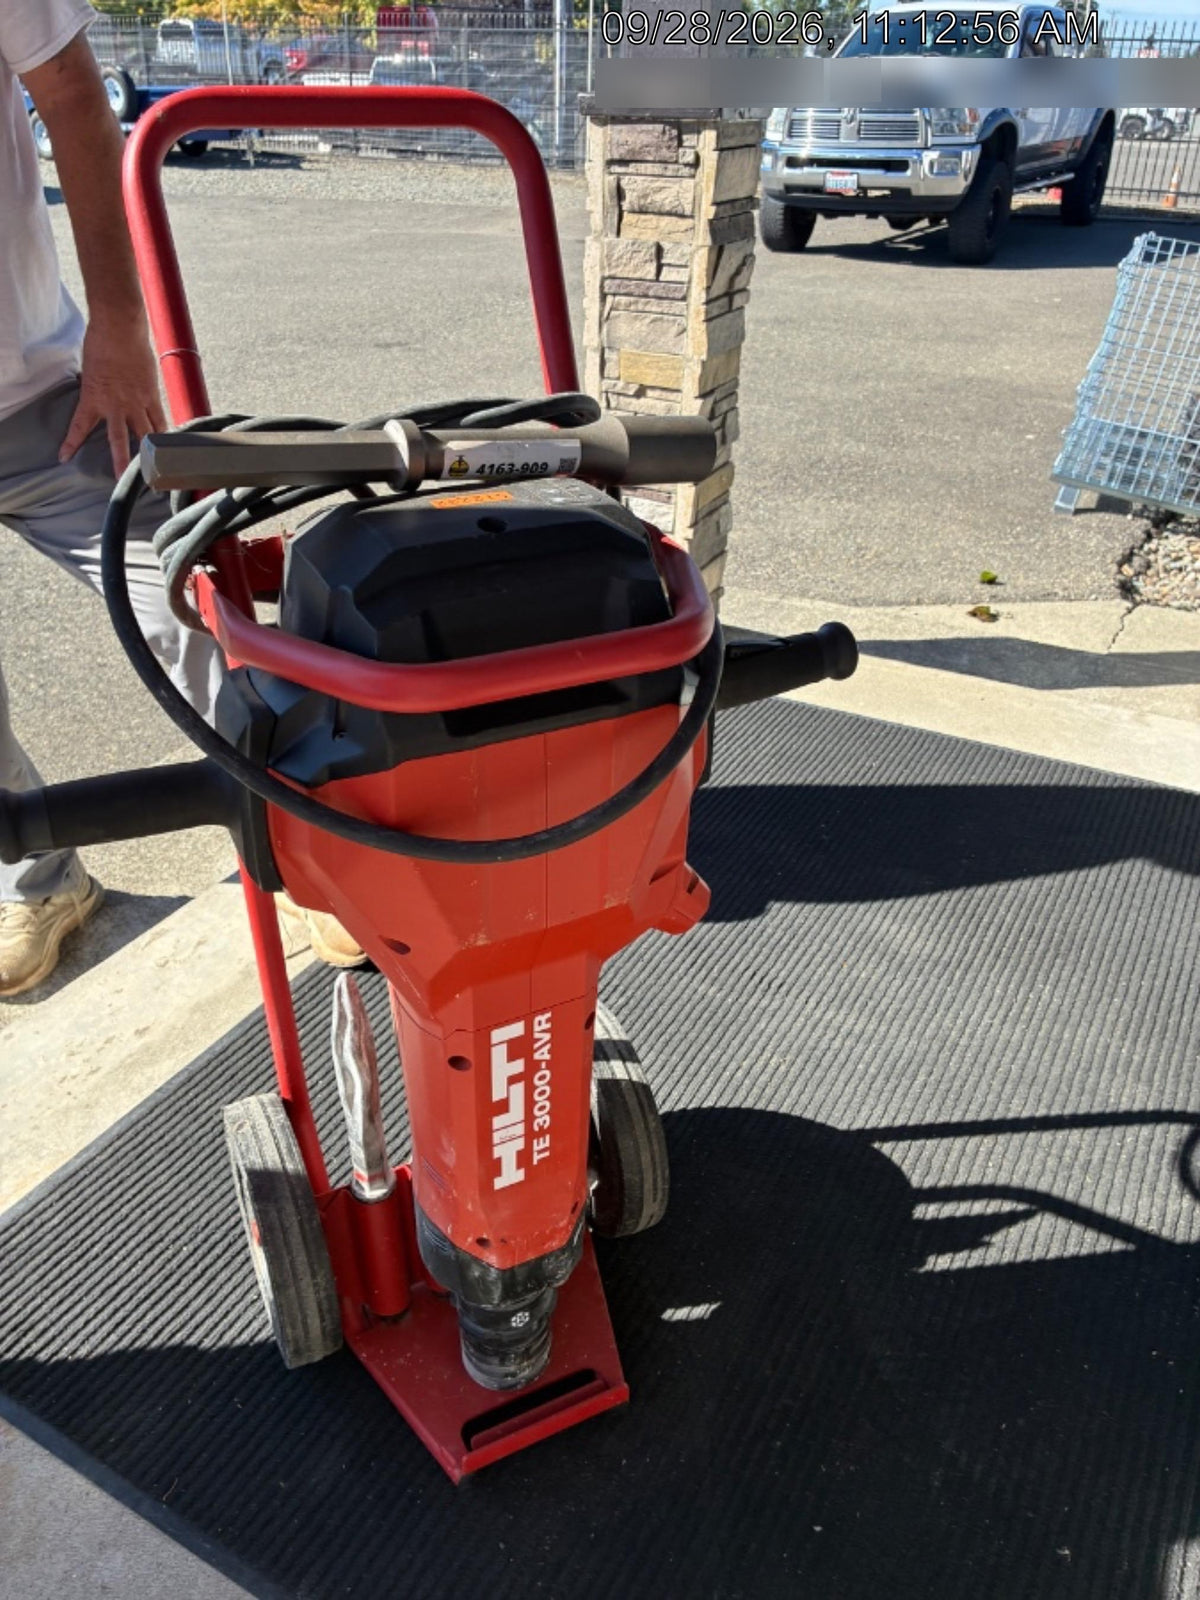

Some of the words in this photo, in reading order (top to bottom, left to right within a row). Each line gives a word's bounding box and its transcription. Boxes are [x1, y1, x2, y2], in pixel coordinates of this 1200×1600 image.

[475, 461, 549, 476] 4163-909
[490, 1020, 525, 1190] HILTI
[533, 1012, 552, 1131] 3000-AVR
[533, 1134, 550, 1165] TE
